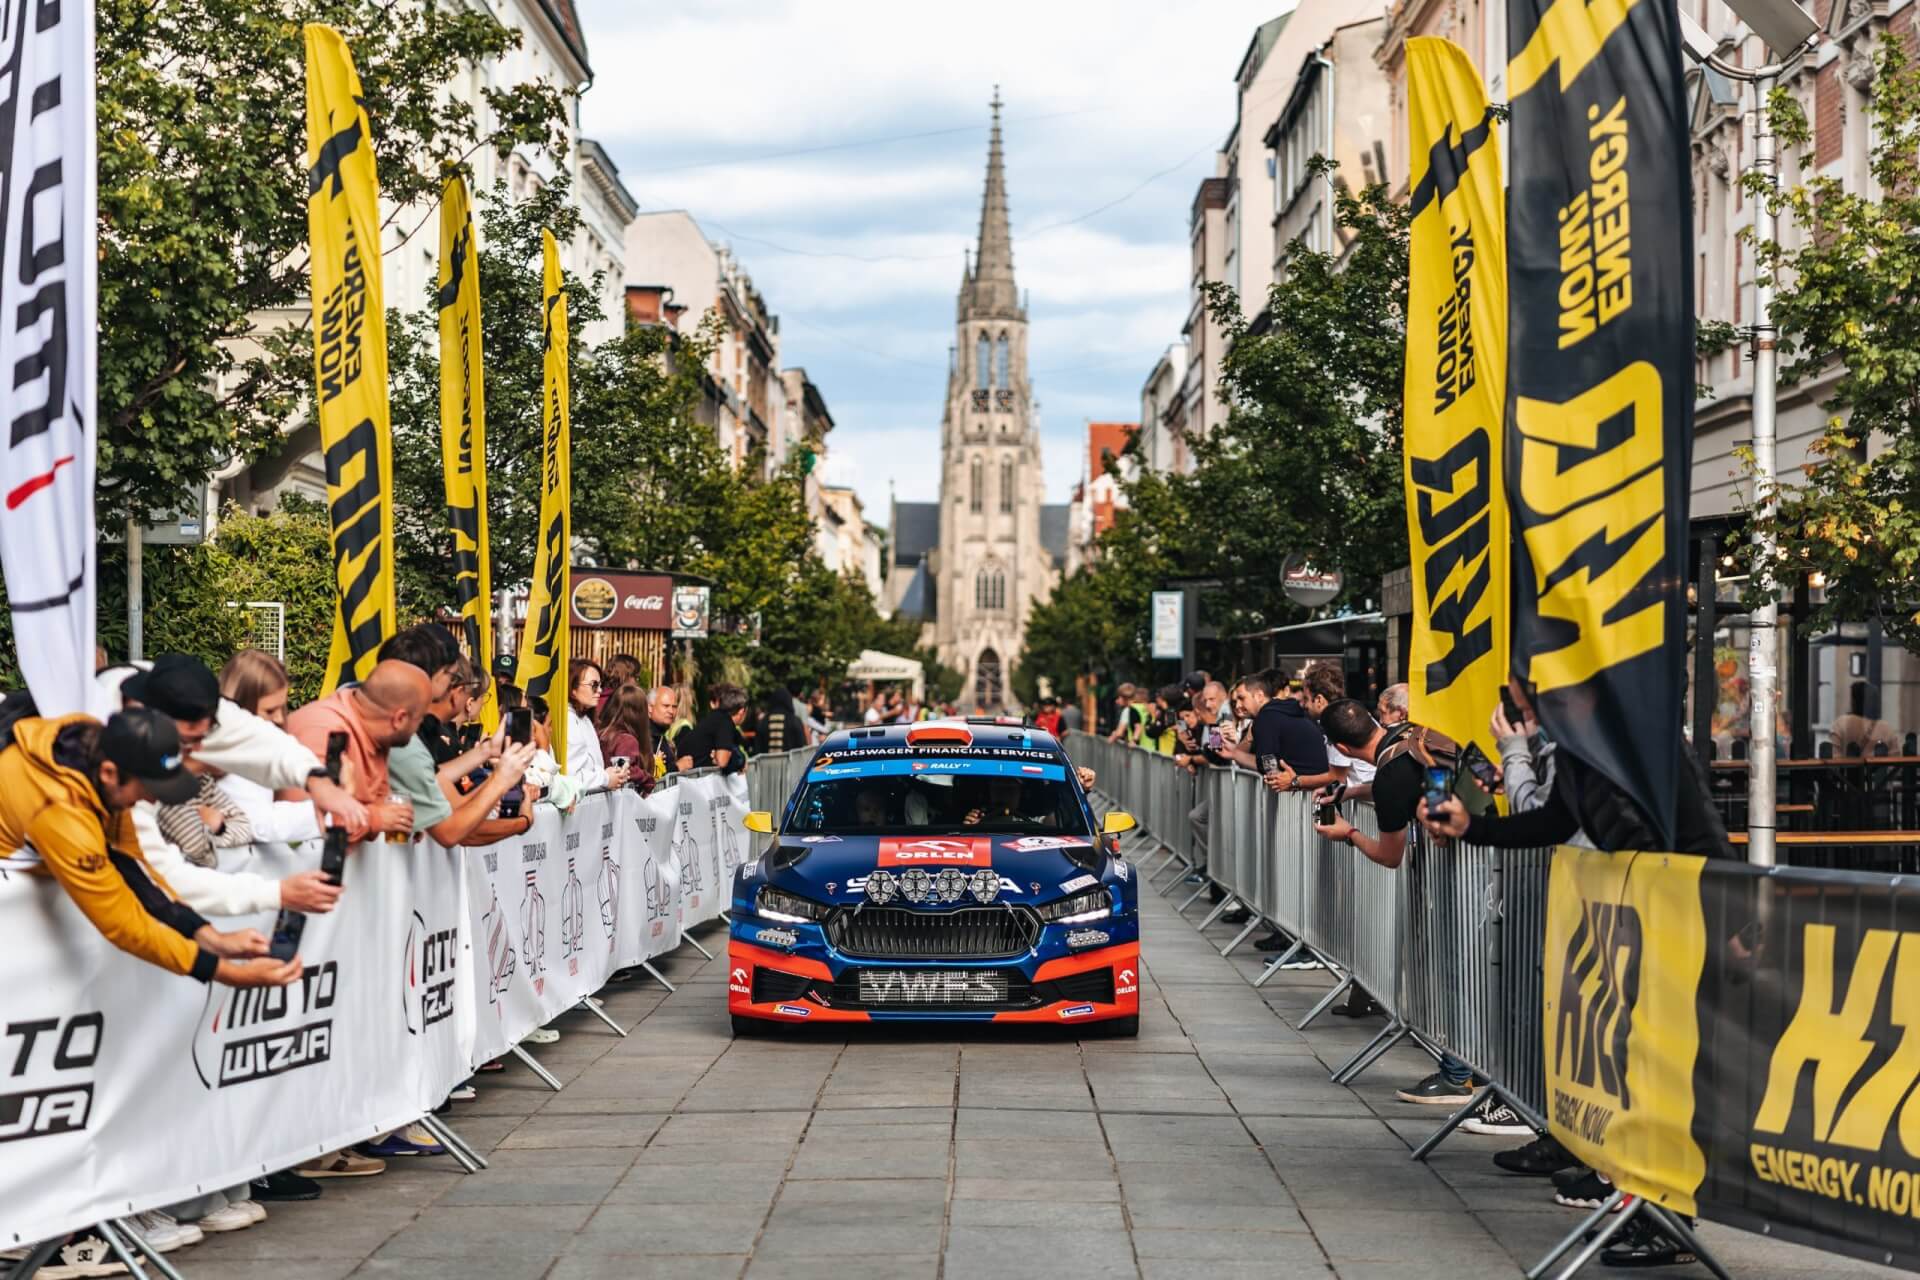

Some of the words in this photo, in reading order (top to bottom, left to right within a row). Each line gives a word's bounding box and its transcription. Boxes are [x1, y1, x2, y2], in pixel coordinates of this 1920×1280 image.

[824, 747, 914, 758] VOLKSWAGEN
[918, 746, 988, 755] FINANCIAL
[992, 749, 1054, 759] SERVICES
[896, 851, 974, 859] ORLEN
[730, 983, 750, 994] ORLEN
[1117, 985, 1137, 994] ORLEN
[220, 1023, 331, 1084] WIZJA
[1750, 1143, 1865, 1206] ENERGY.
